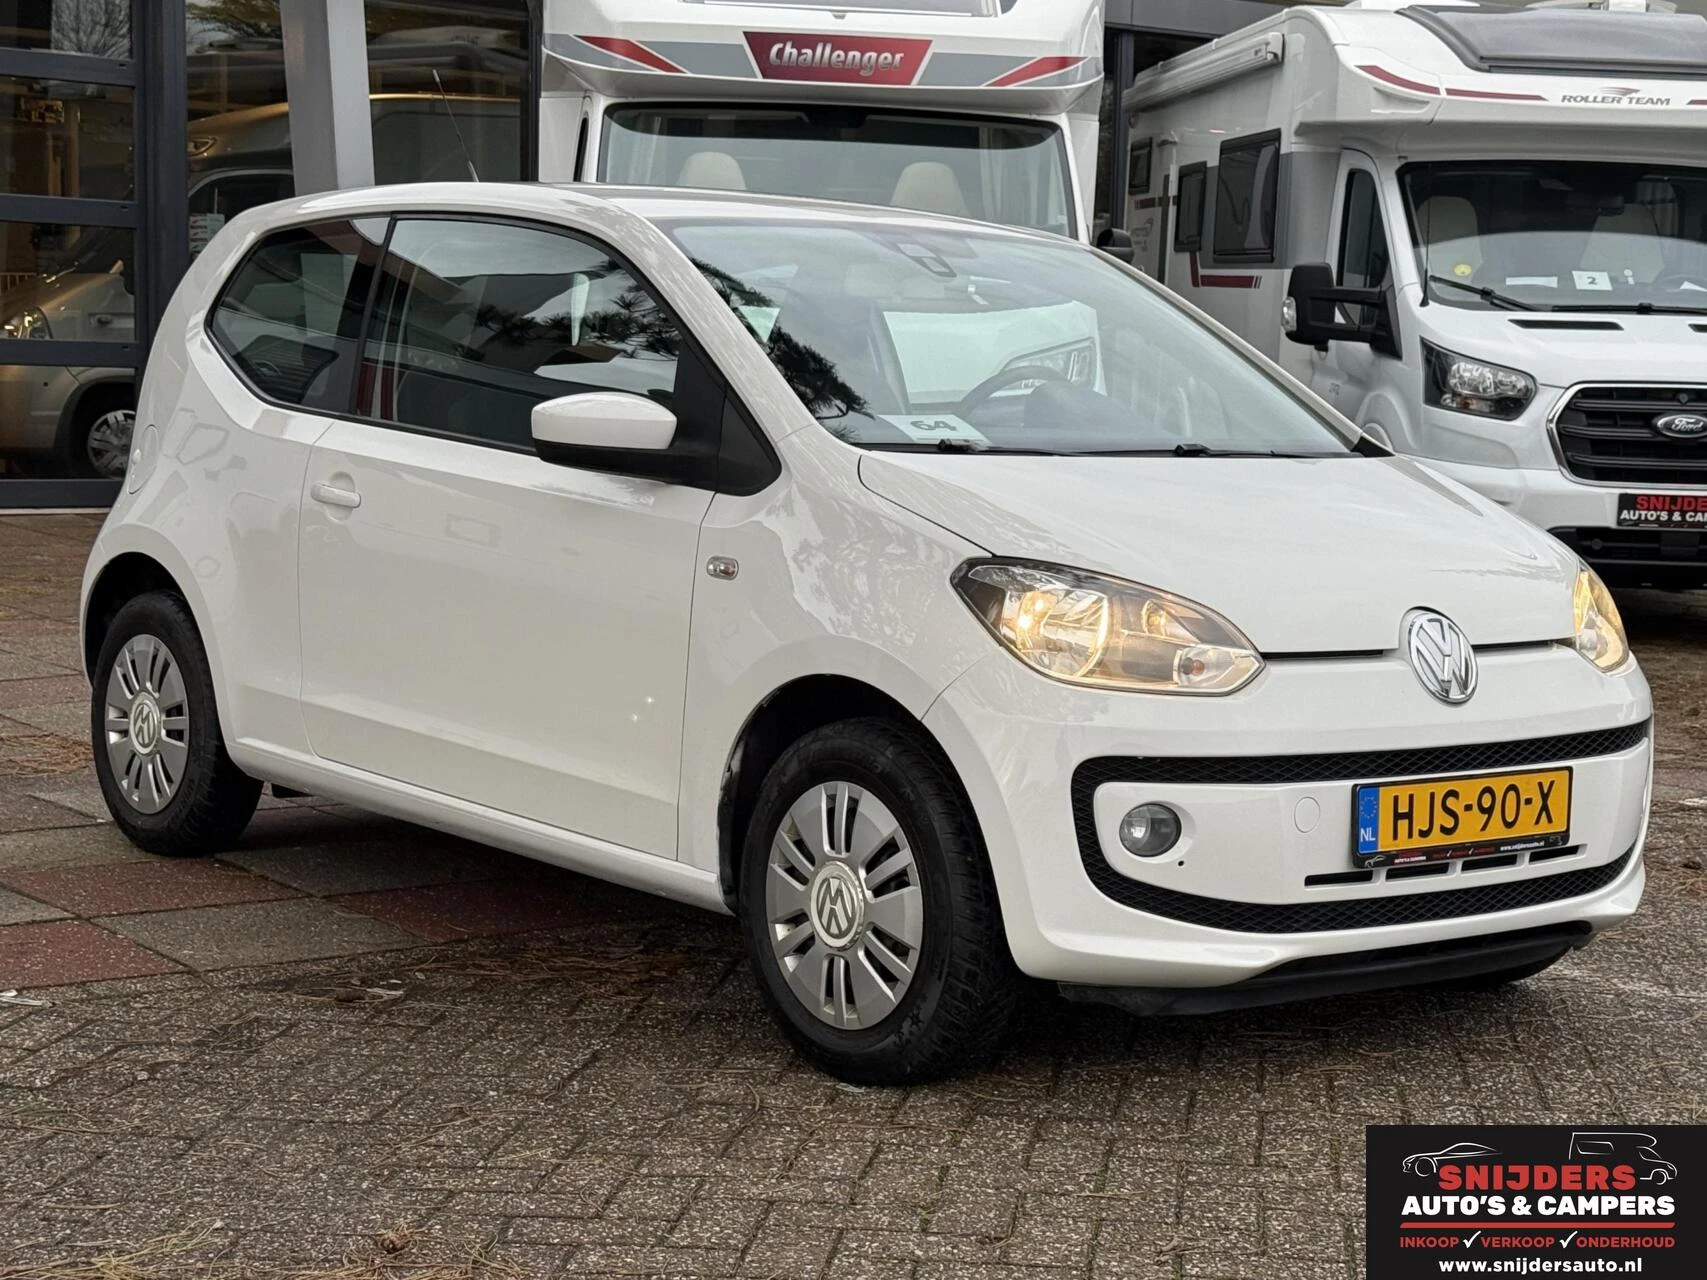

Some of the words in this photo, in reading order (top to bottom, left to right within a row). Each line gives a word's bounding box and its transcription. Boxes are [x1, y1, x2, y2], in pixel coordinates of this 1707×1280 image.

[769, 41, 904, 76] Challenger
[1561, 94, 1623, 105] ROLLER
[1627, 96, 1671, 106] TEAM
[1587, 276, 1598, 286] 2
[910, 420, 957, 431] 64
[1671, 418, 1704, 433] Ford
[1620, 510, 1668, 521] AUTO'S
[1672, 511, 1682, 522] &
[1392, 779, 1556, 841] HJS-90-X
[1360, 827, 1376, 842] NL
